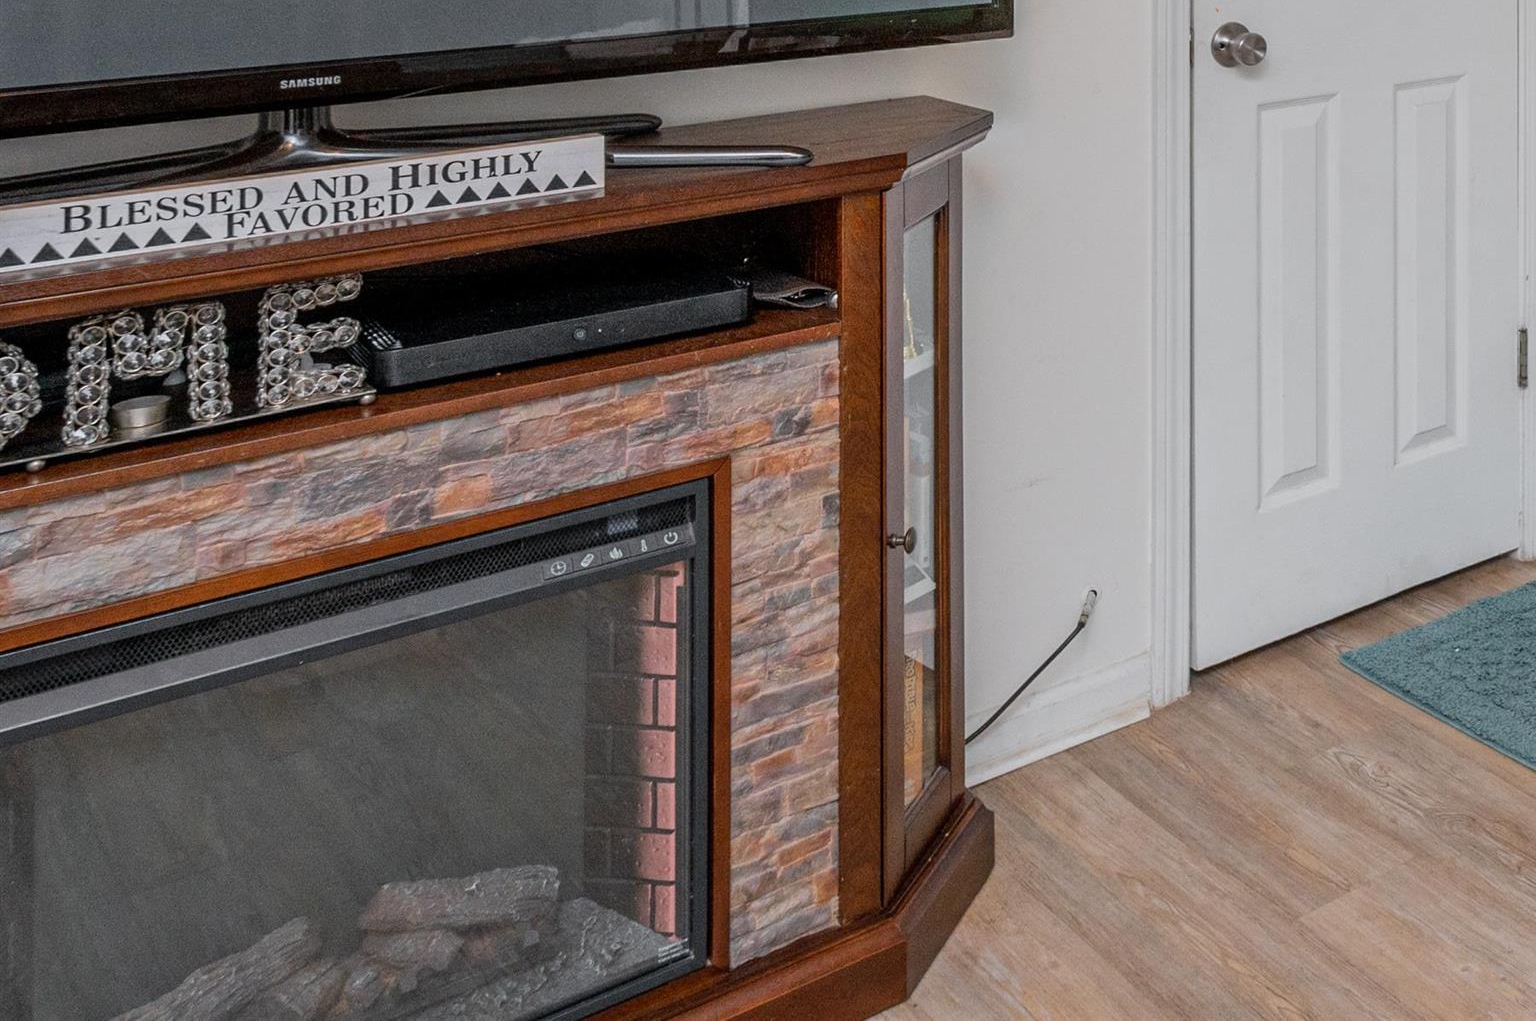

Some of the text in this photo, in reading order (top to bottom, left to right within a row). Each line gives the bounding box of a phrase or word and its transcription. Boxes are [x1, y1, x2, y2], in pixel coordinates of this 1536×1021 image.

[279, 74, 342, 90] SAMSUNG
[60, 149, 543, 235] BLESSED AND HIGHLY
[223, 193, 416, 240] FAVORED
